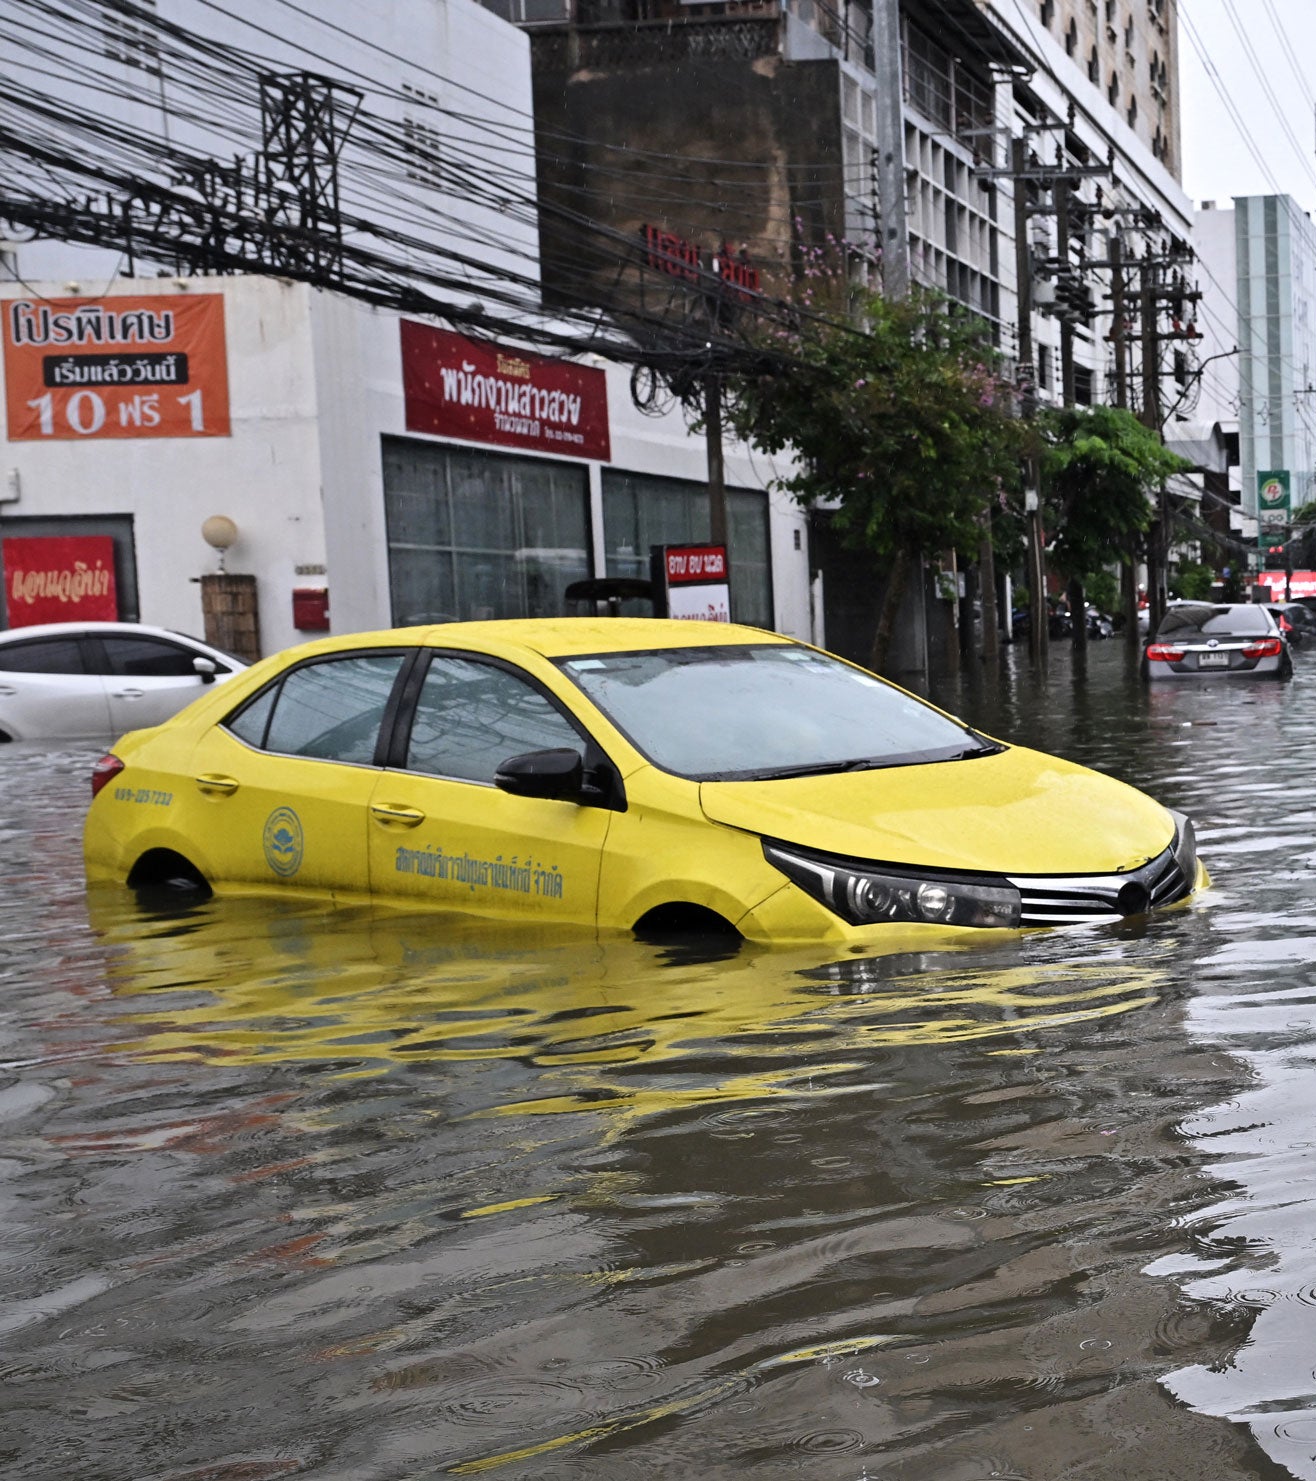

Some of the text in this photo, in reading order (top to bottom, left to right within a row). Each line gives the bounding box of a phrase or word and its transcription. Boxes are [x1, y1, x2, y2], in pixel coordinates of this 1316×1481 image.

[12, 301, 172, 343] โปรพิเศษ
[54, 355, 177, 383] เริ่มแล้ววันนี้
[118, 394, 161, 427] ฟรี
[177, 389, 204, 431] 1
[440, 359, 581, 426] พนักงานสาวสวย
